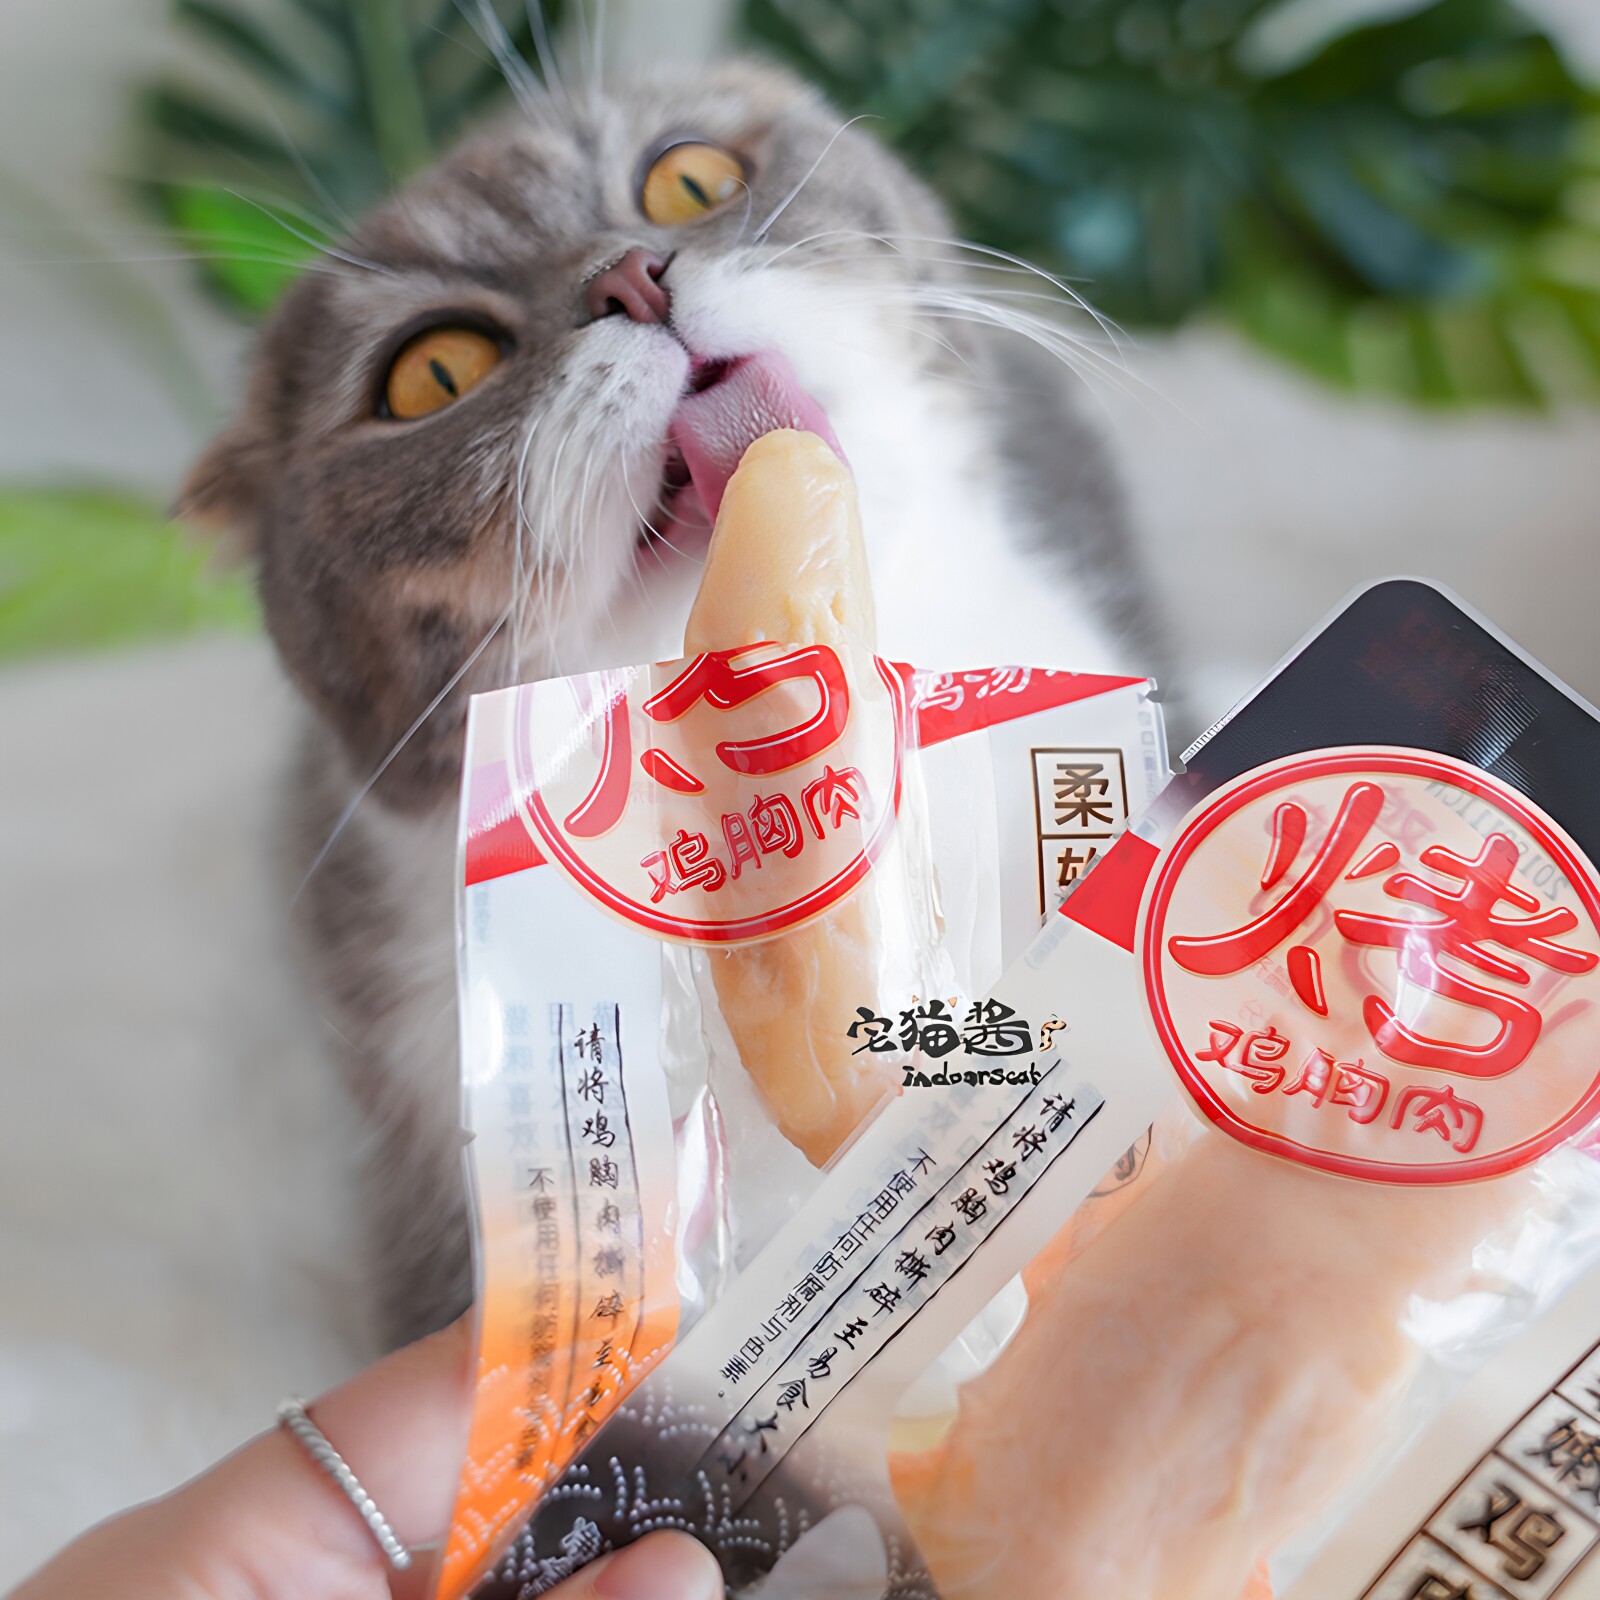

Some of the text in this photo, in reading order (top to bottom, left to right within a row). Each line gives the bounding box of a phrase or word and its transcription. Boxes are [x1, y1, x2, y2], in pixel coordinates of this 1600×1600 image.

[640, 765, 867, 904] 鸡胸肉
[1167, 781, 1600, 1080] 烤
[1195, 1018, 1485, 1154] 鸡胸肉
